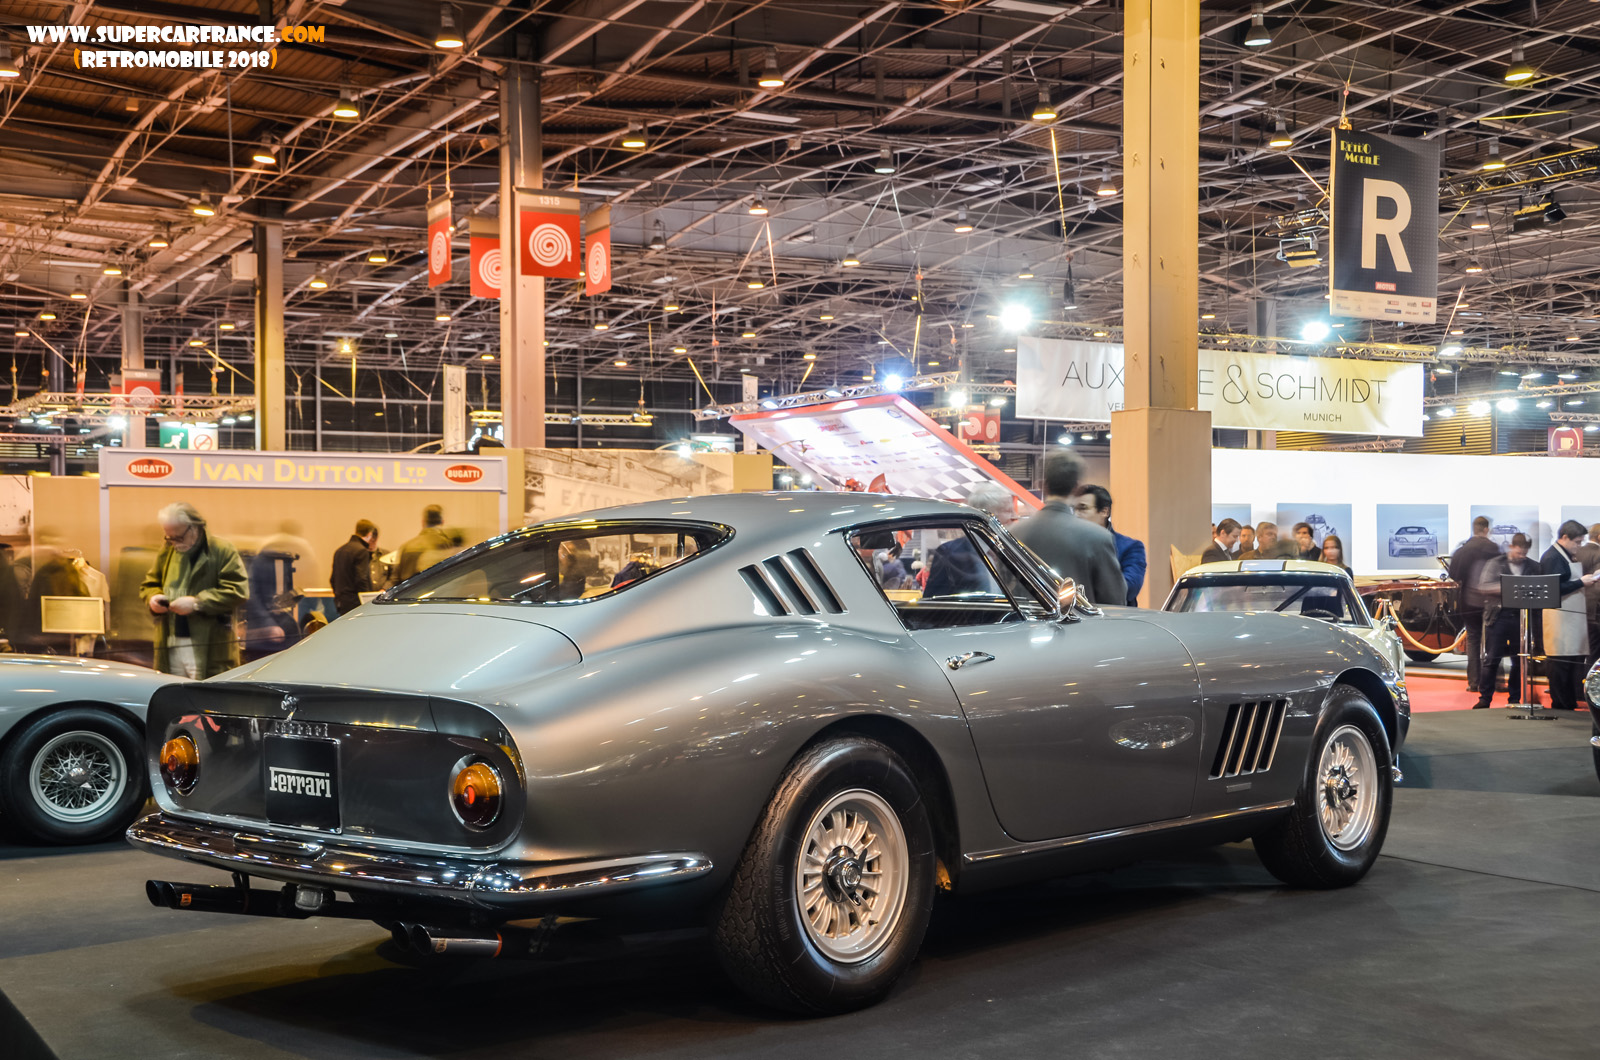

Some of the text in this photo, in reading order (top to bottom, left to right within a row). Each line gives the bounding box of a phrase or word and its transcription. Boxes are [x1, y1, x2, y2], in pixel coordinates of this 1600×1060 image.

[539, 196, 560, 206] 1315
[1361, 177, 1413, 273] R
[1222, 364, 1251, 405] &
[1257, 372, 1387, 404] SCHMIDT
[1303, 412, 1342, 423] MUNICH
[130, 464, 169, 475] BUGATTI
[193, 457, 264, 482] IVAN
[274, 458, 384, 483] DUTTON
[447, 469, 480, 479] BUGATTI
[269, 766, 332, 798] Ferrari
